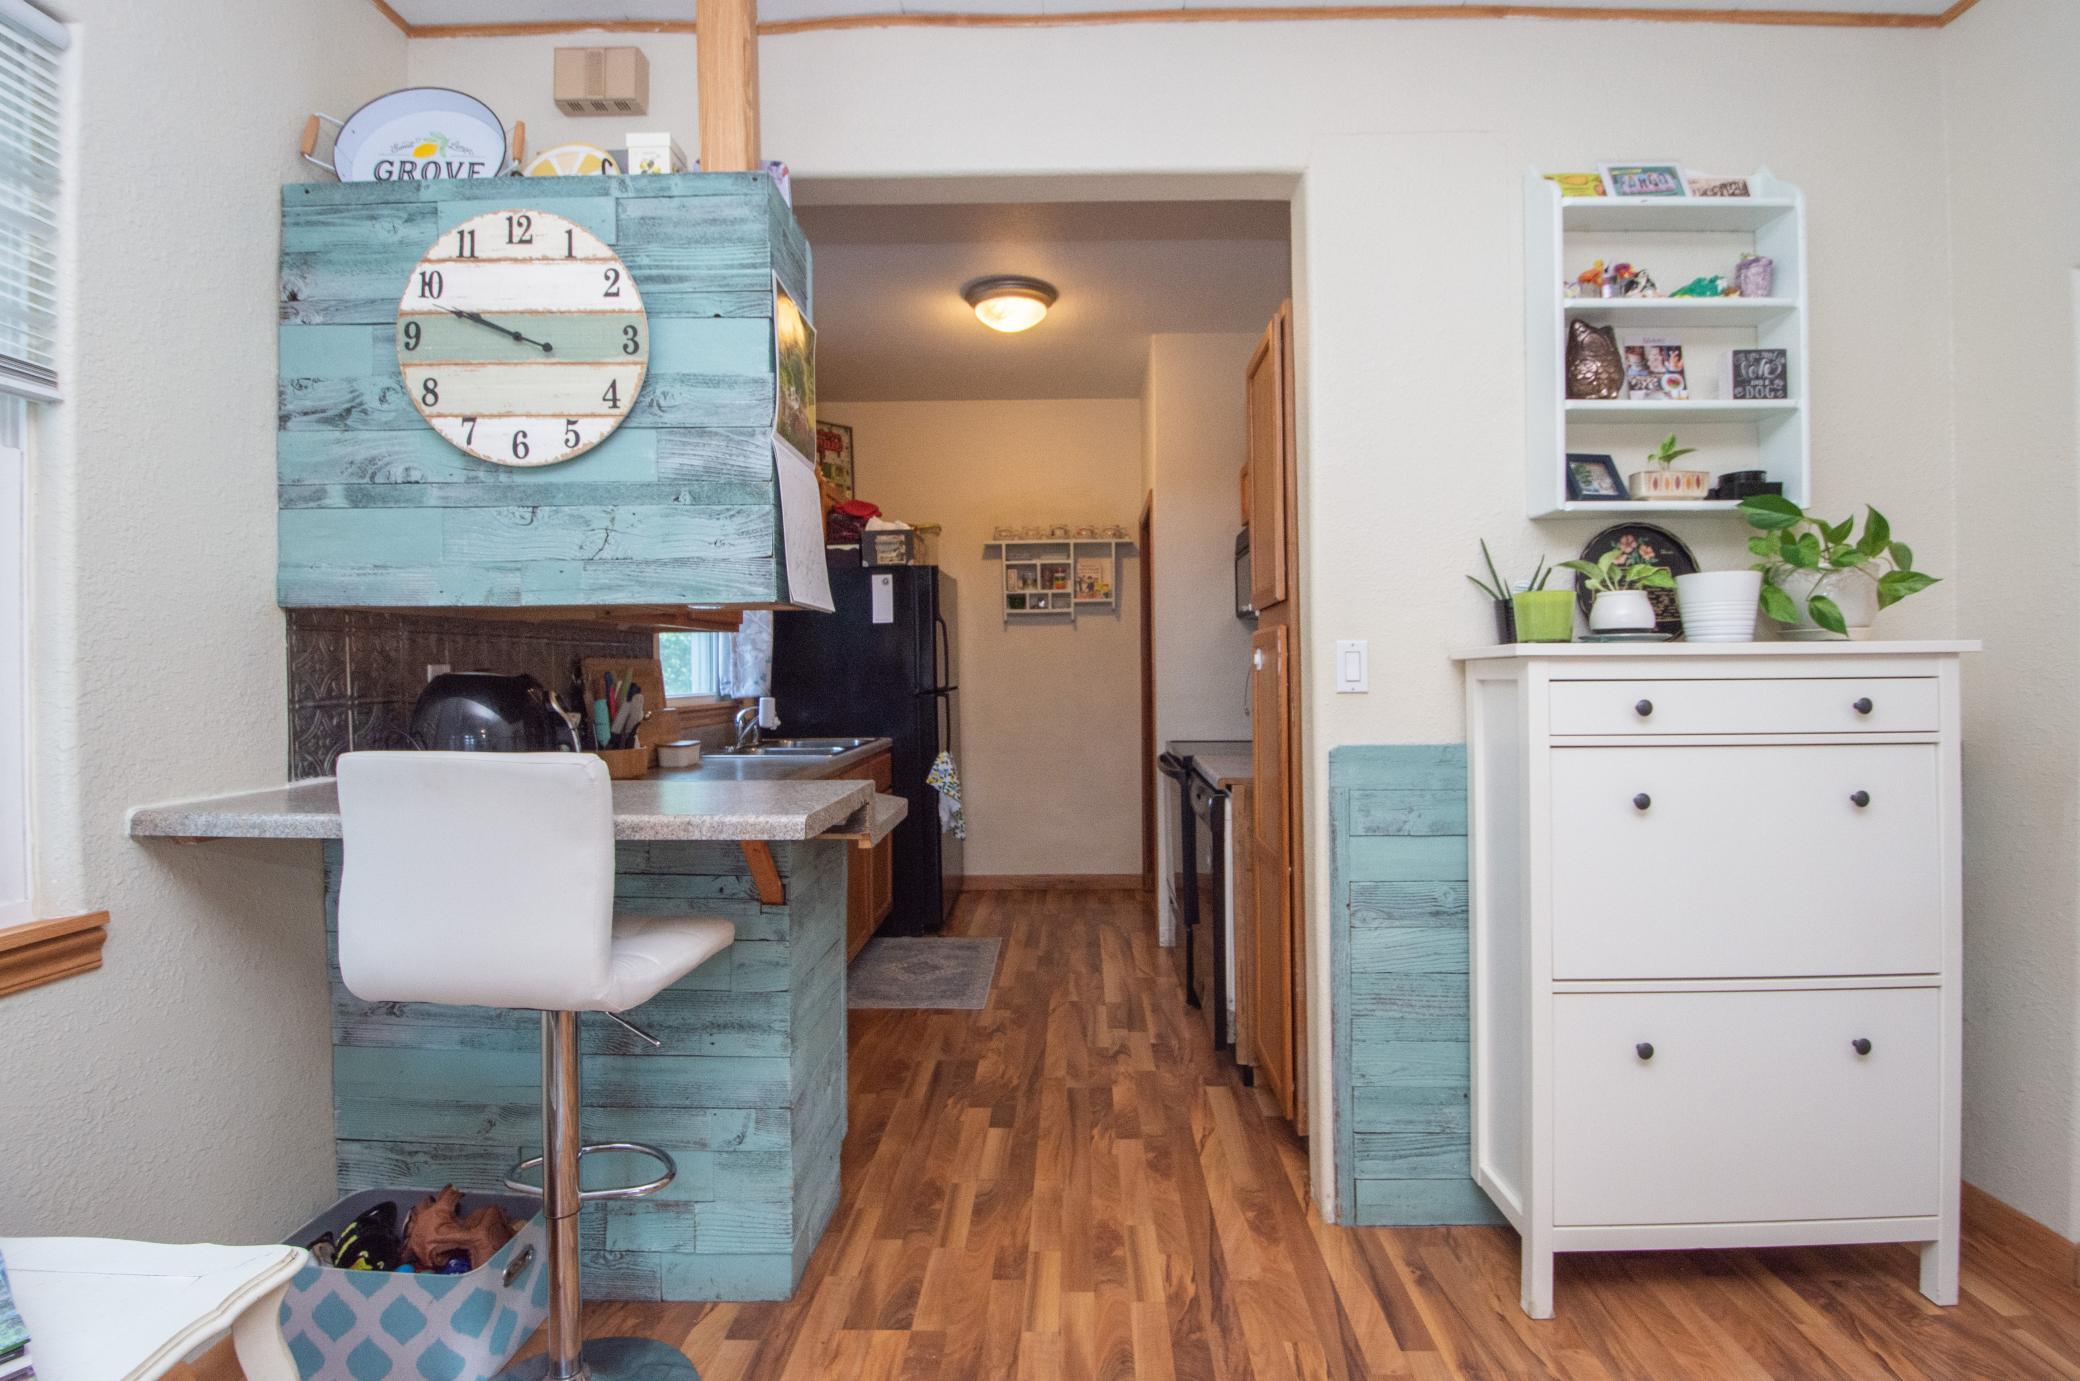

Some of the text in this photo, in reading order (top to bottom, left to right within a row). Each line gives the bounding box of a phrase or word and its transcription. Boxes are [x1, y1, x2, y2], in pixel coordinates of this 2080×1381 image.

[373, 160, 486, 181] GROVE
[456, 229, 479, 259] 11
[505, 215, 533, 245] 12
[564, 229, 577, 259] 1
[418, 270, 444, 299] 10
[603, 268, 620, 297] 2
[404, 321, 421, 351] 9
[622, 324, 640, 355] 3
[422, 377, 439, 407] 8
[602, 378, 621, 409] 4
[1745, 385, 1776, 399] DOG
[461, 417, 478, 446] 7
[512, 430, 530, 459] 6
[564, 419, 581, 449] 5
